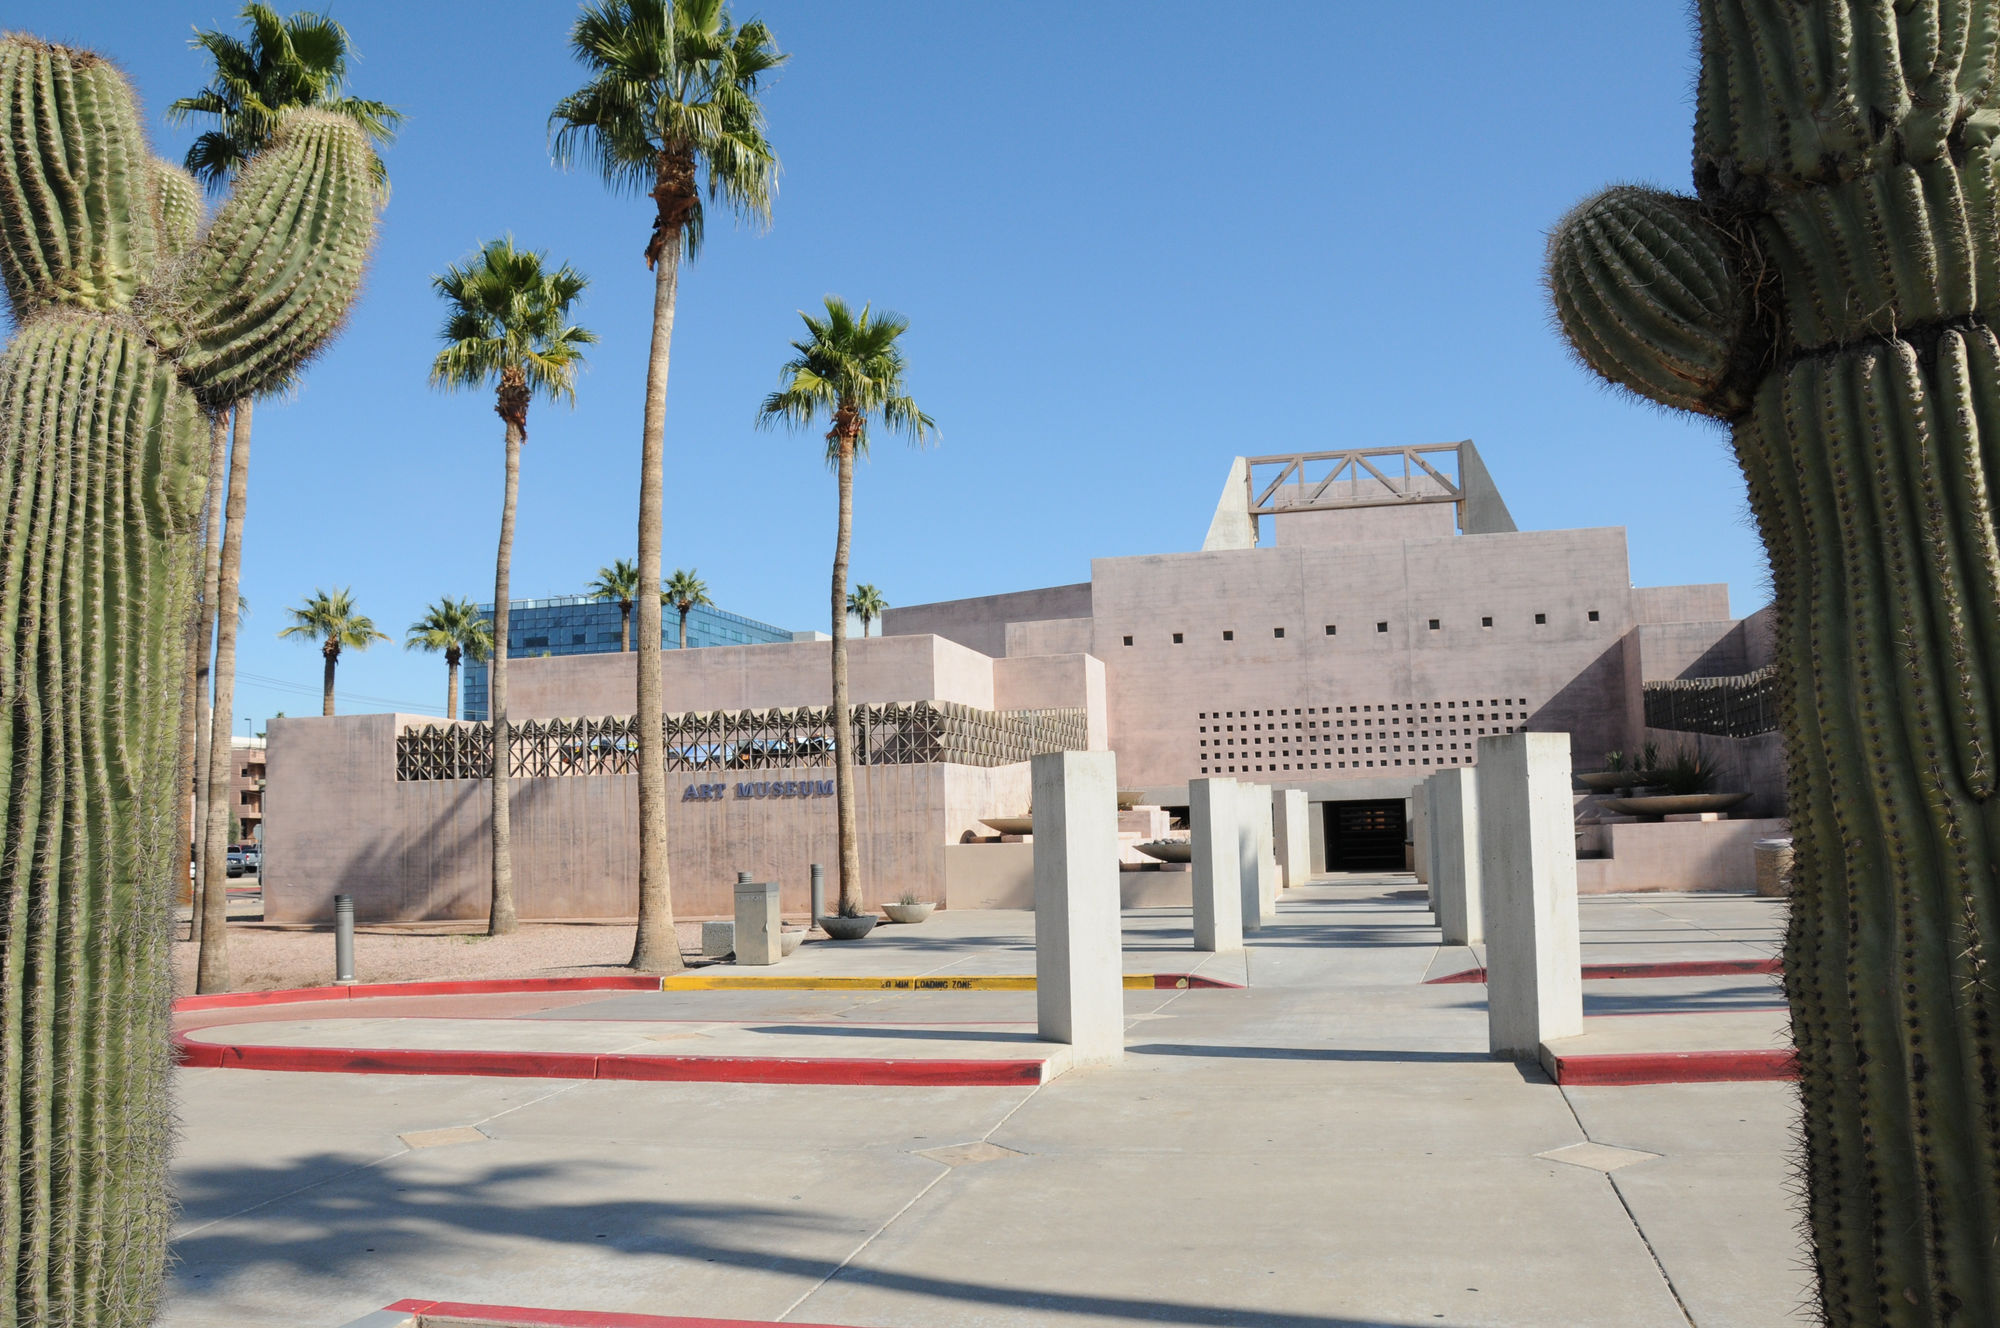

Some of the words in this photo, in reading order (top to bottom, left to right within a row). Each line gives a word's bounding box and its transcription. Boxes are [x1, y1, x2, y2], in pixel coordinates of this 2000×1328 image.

[684, 783, 727, 800] ART
[736, 779, 834, 798] MUSEUM
[915, 980, 949, 989] LOADING
[952, 980, 973, 989] ZONE
